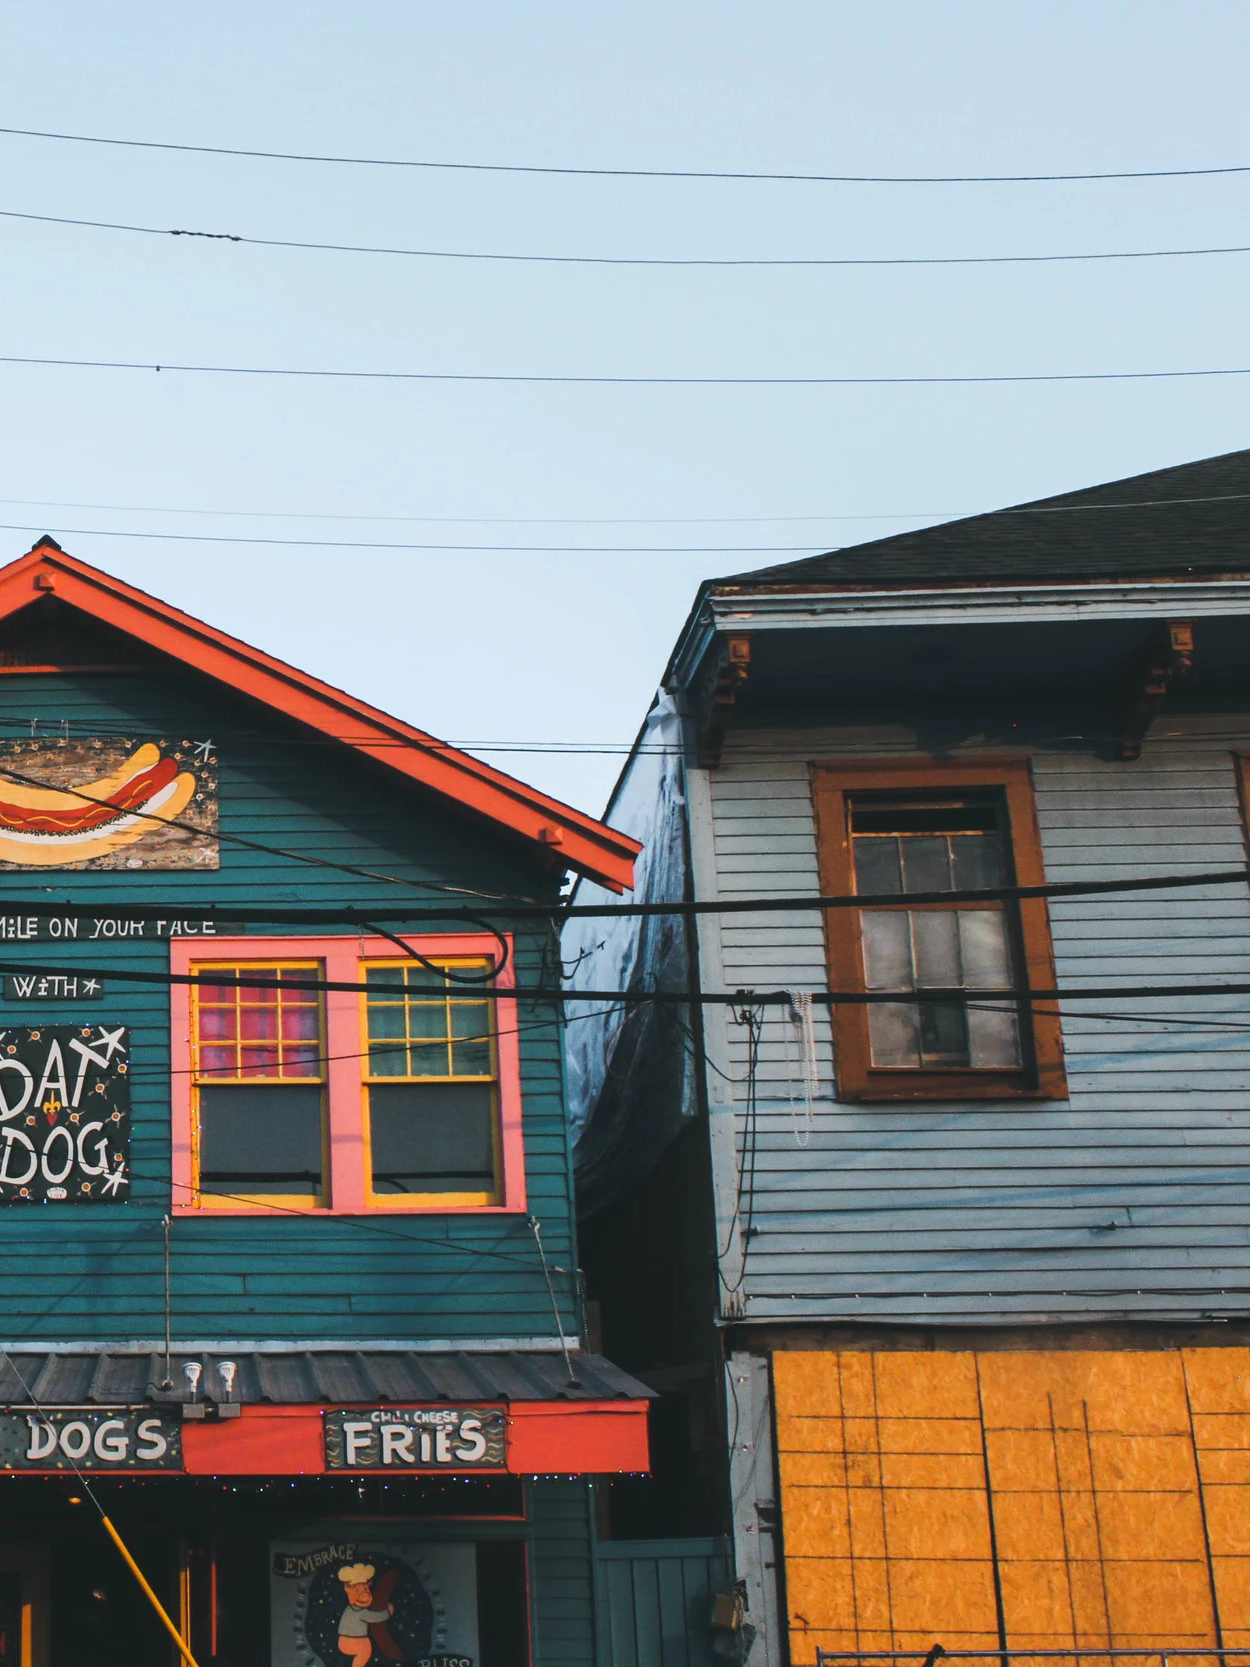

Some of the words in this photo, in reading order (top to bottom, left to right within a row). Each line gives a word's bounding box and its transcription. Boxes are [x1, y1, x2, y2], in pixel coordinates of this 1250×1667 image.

[49, 917, 79, 938] ON
[89, 918, 145, 939] YOUR
[413, 1410, 459, 1424] CHEESE
[27, 1415, 167, 1460] DOGS
[343, 1419, 486, 1464] FRIES
[282, 1543, 356, 1576] EMBRACE
